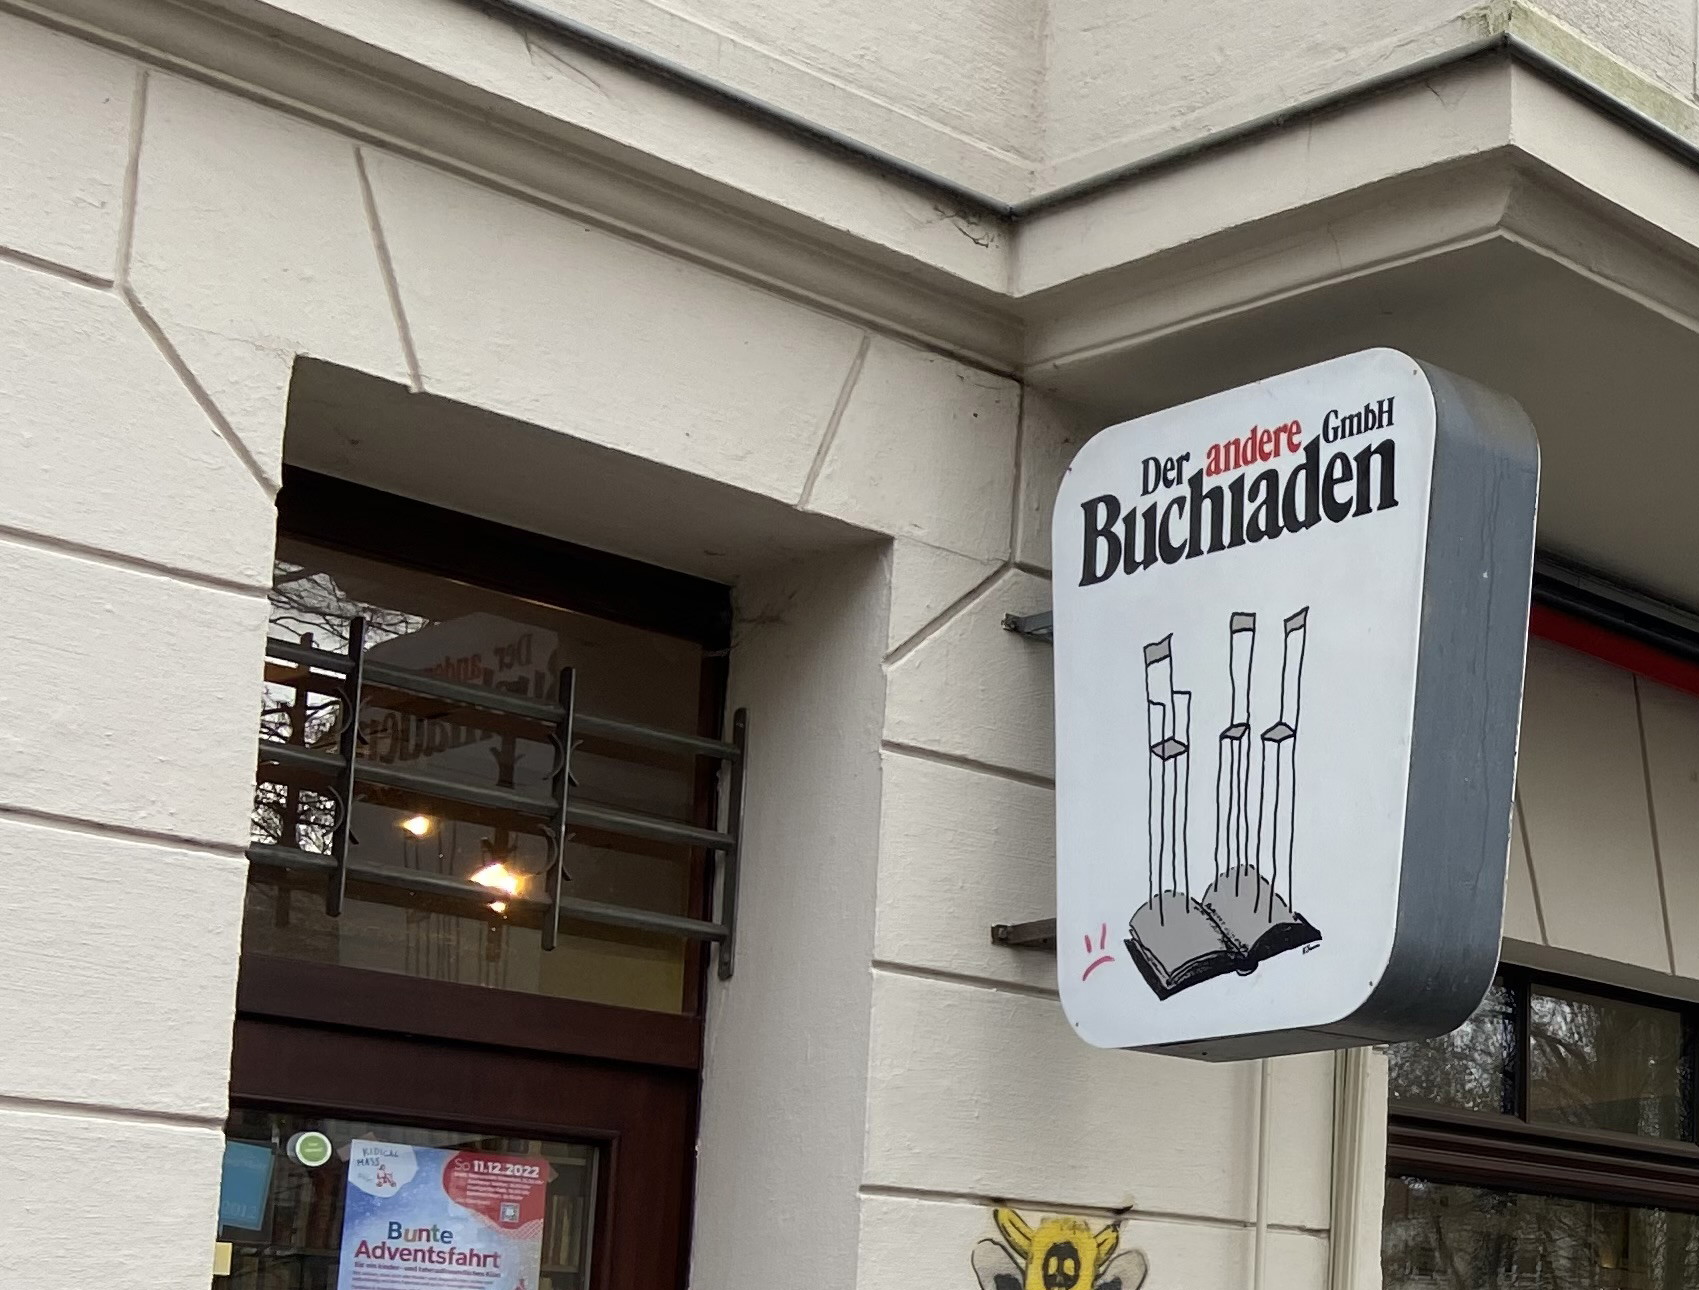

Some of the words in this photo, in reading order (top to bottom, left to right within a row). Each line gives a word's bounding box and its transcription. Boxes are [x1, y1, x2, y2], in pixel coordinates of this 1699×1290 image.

[1140, 452, 1190, 496] Der
[1206, 419, 1302, 476] andere
[1322, 397, 1395, 444] GmbH
[1079, 437, 1399, 587] Buchladen
[454, 1158, 470, 1171] So
[473, 1160, 540, 1178] 11.12.2022
[388, 1221, 454, 1244] Bunte
[354, 1240, 500, 1269] Adventsfahrt
